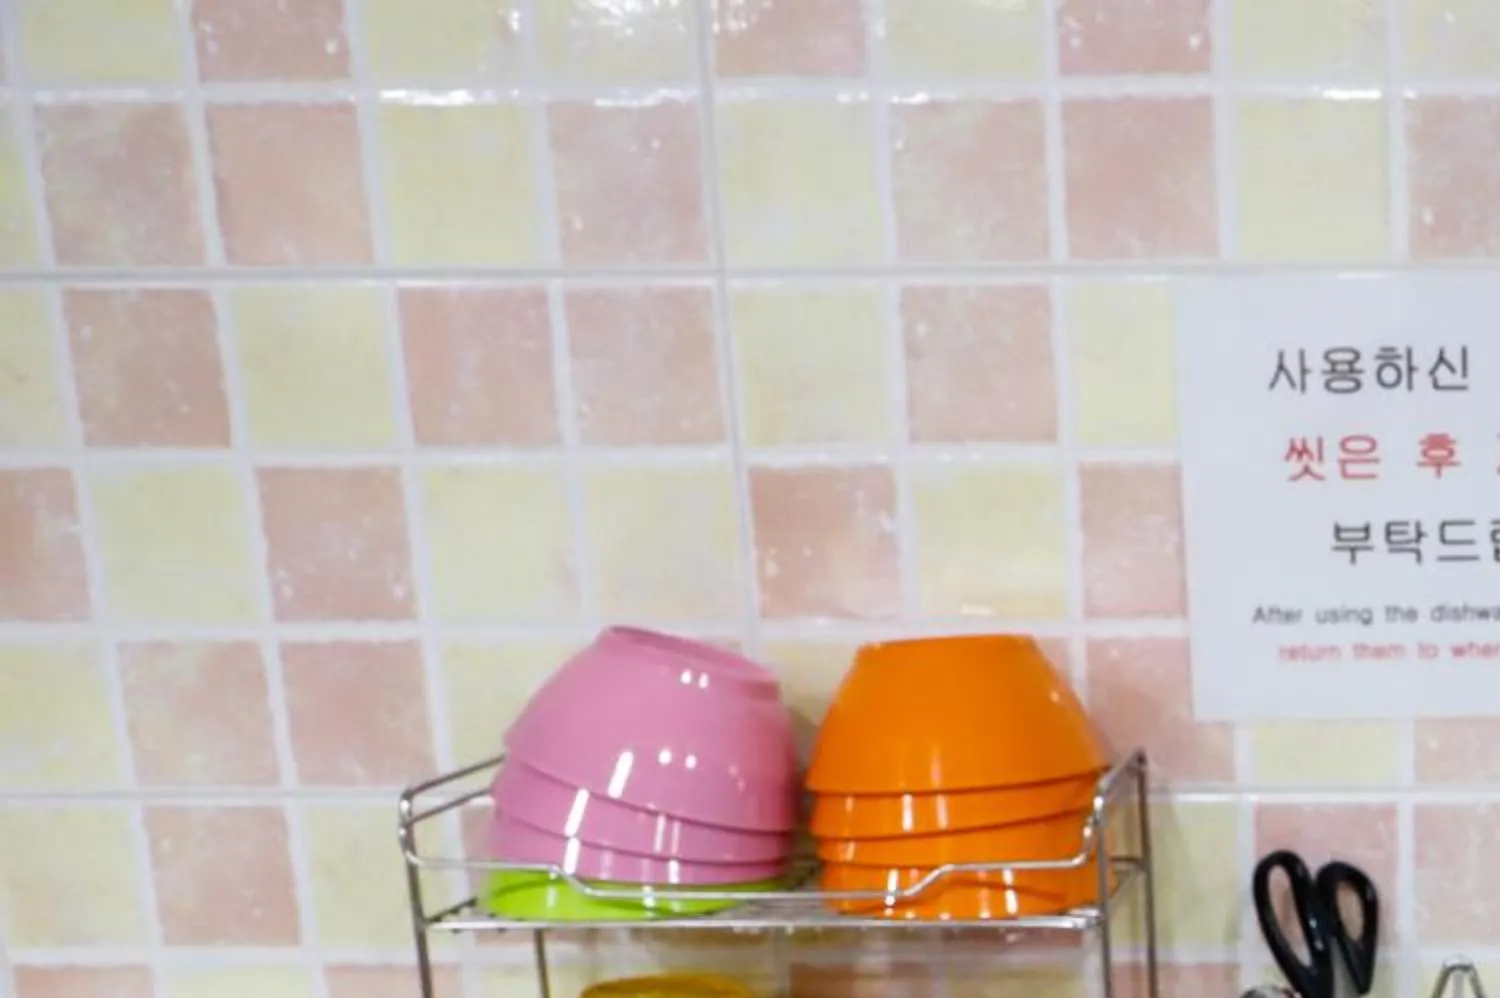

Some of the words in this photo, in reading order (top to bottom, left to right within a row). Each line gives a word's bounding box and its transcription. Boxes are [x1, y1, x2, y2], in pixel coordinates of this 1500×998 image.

[1266, 346, 1472, 395] 사용하신
[1284, 434, 1382, 482] 씻은
[1415, 433, 1462, 479] 후
[1252, 605, 1303, 625] After
[1315, 605, 1374, 626] using
[1384, 604, 1419, 624] the
[1279, 643, 1342, 663] return
[1353, 642, 1407, 661] them
[1418, 642, 1440, 660] to
